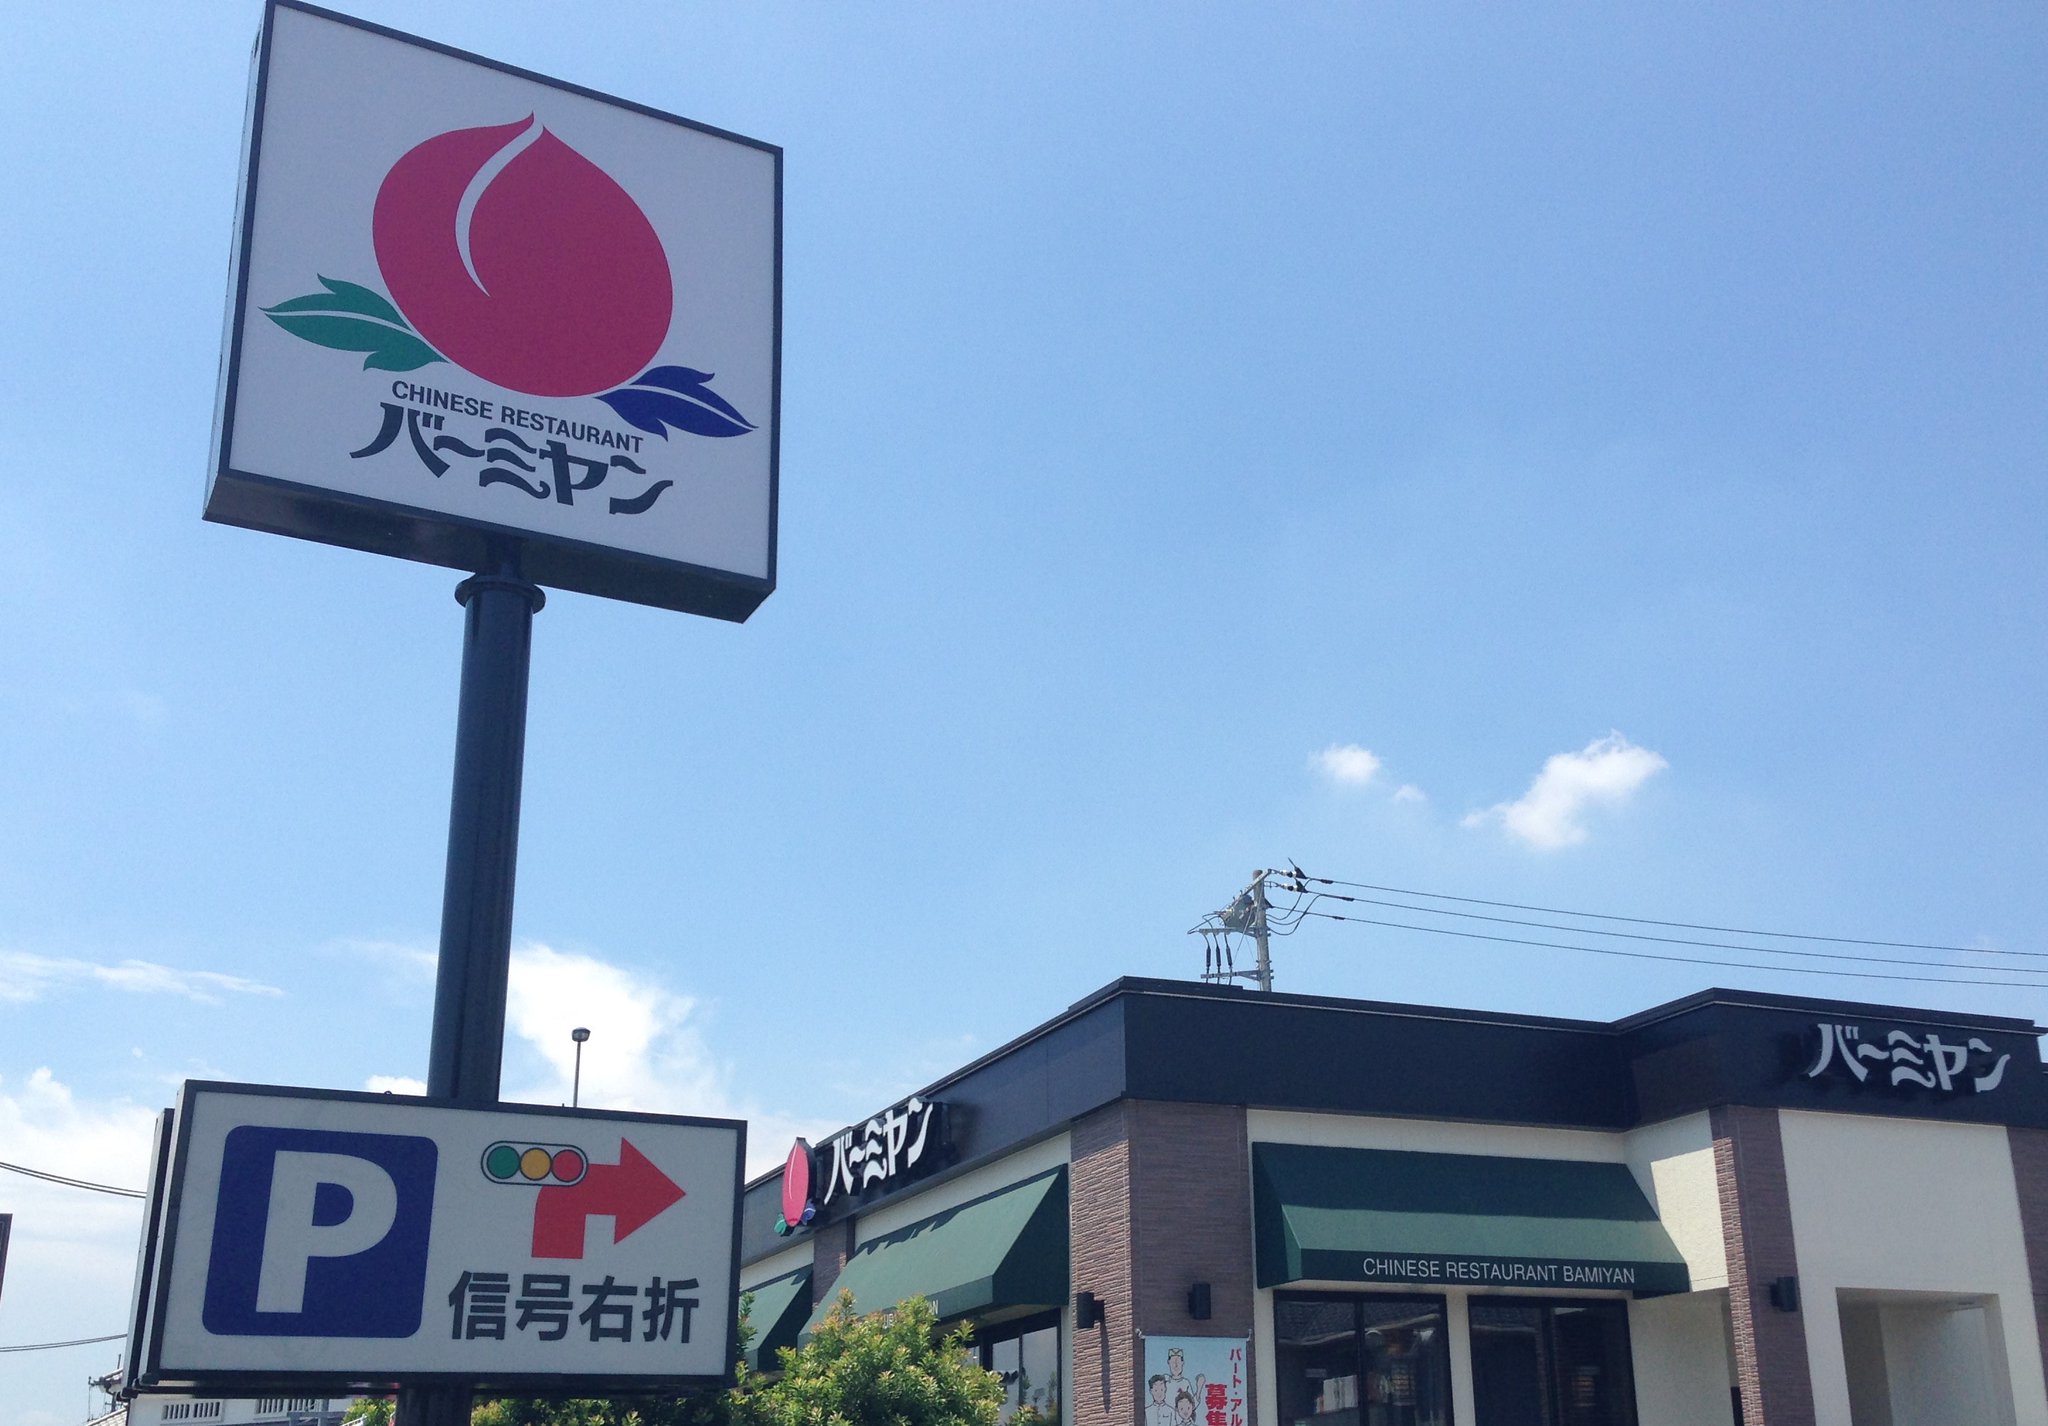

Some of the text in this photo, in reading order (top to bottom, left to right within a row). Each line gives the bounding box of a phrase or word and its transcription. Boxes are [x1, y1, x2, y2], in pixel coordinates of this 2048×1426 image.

[391, 380, 644, 453] CHINESE RESTAURANT
[349, 402, 674, 515] バーミヤン
[1808, 1023, 2011, 1093] バーミヤン
[823, 1097, 934, 1205] バーミヤン
[255, 1150, 398, 1313] P
[448, 1270, 700, 1344] 信号右折
[1362, 1257, 1635, 1284] CHINESE RESTAURANT BAMIYAN
